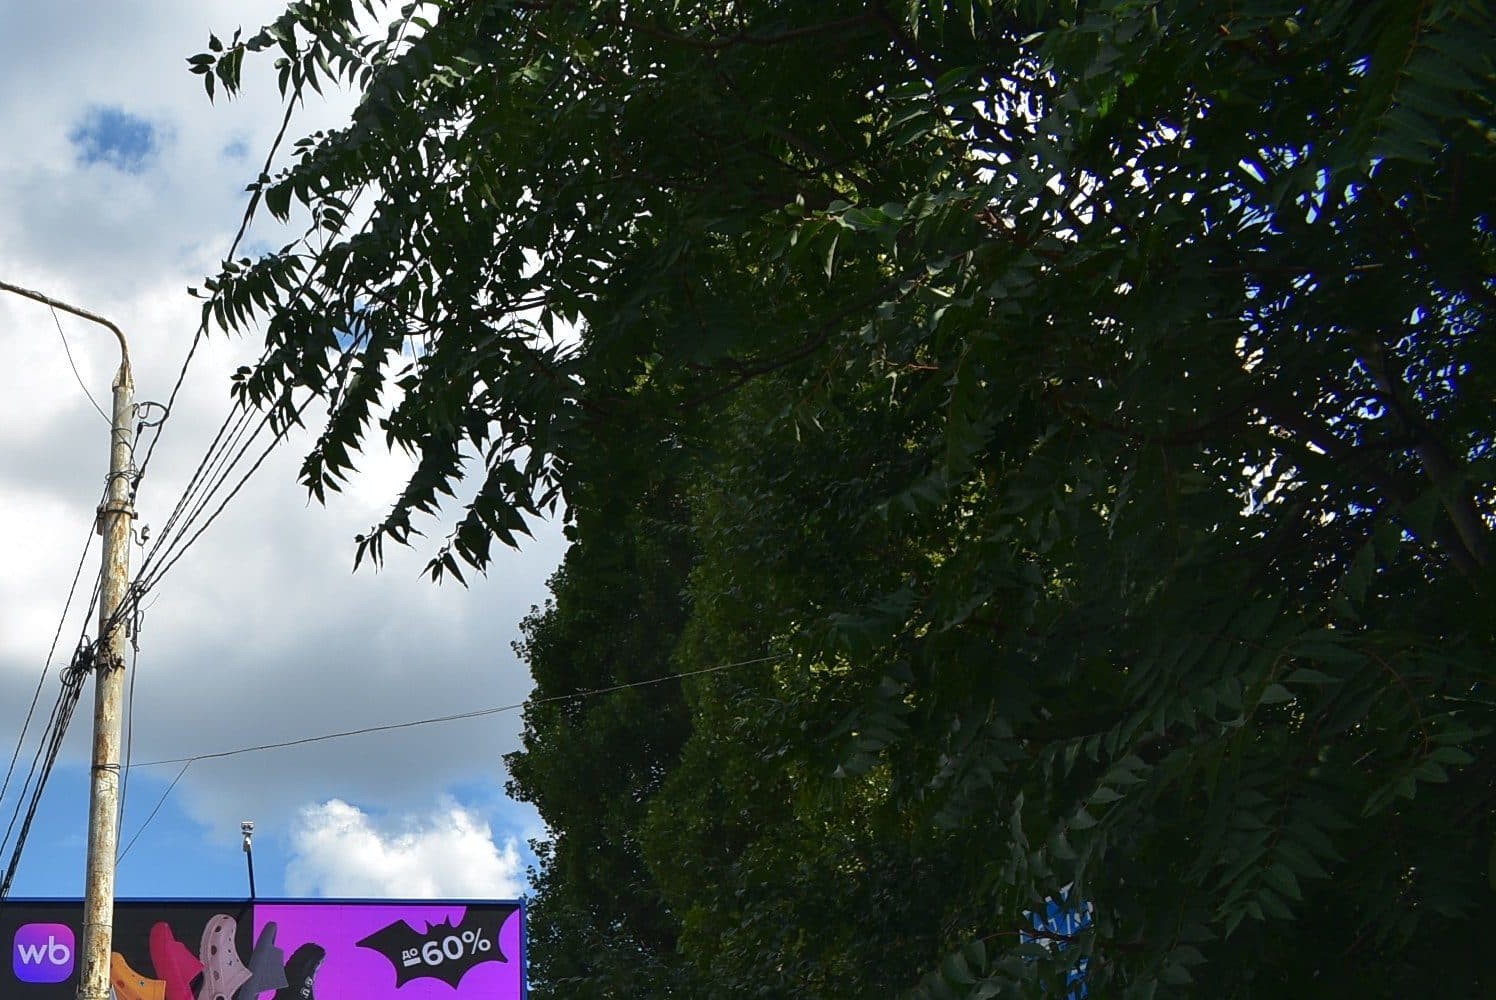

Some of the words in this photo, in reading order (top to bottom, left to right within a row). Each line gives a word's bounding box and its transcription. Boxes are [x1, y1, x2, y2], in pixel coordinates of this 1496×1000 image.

[18, 935, 70, 965] wb
[402, 948, 418, 960] до
[422, 928, 491, 966] 60%
